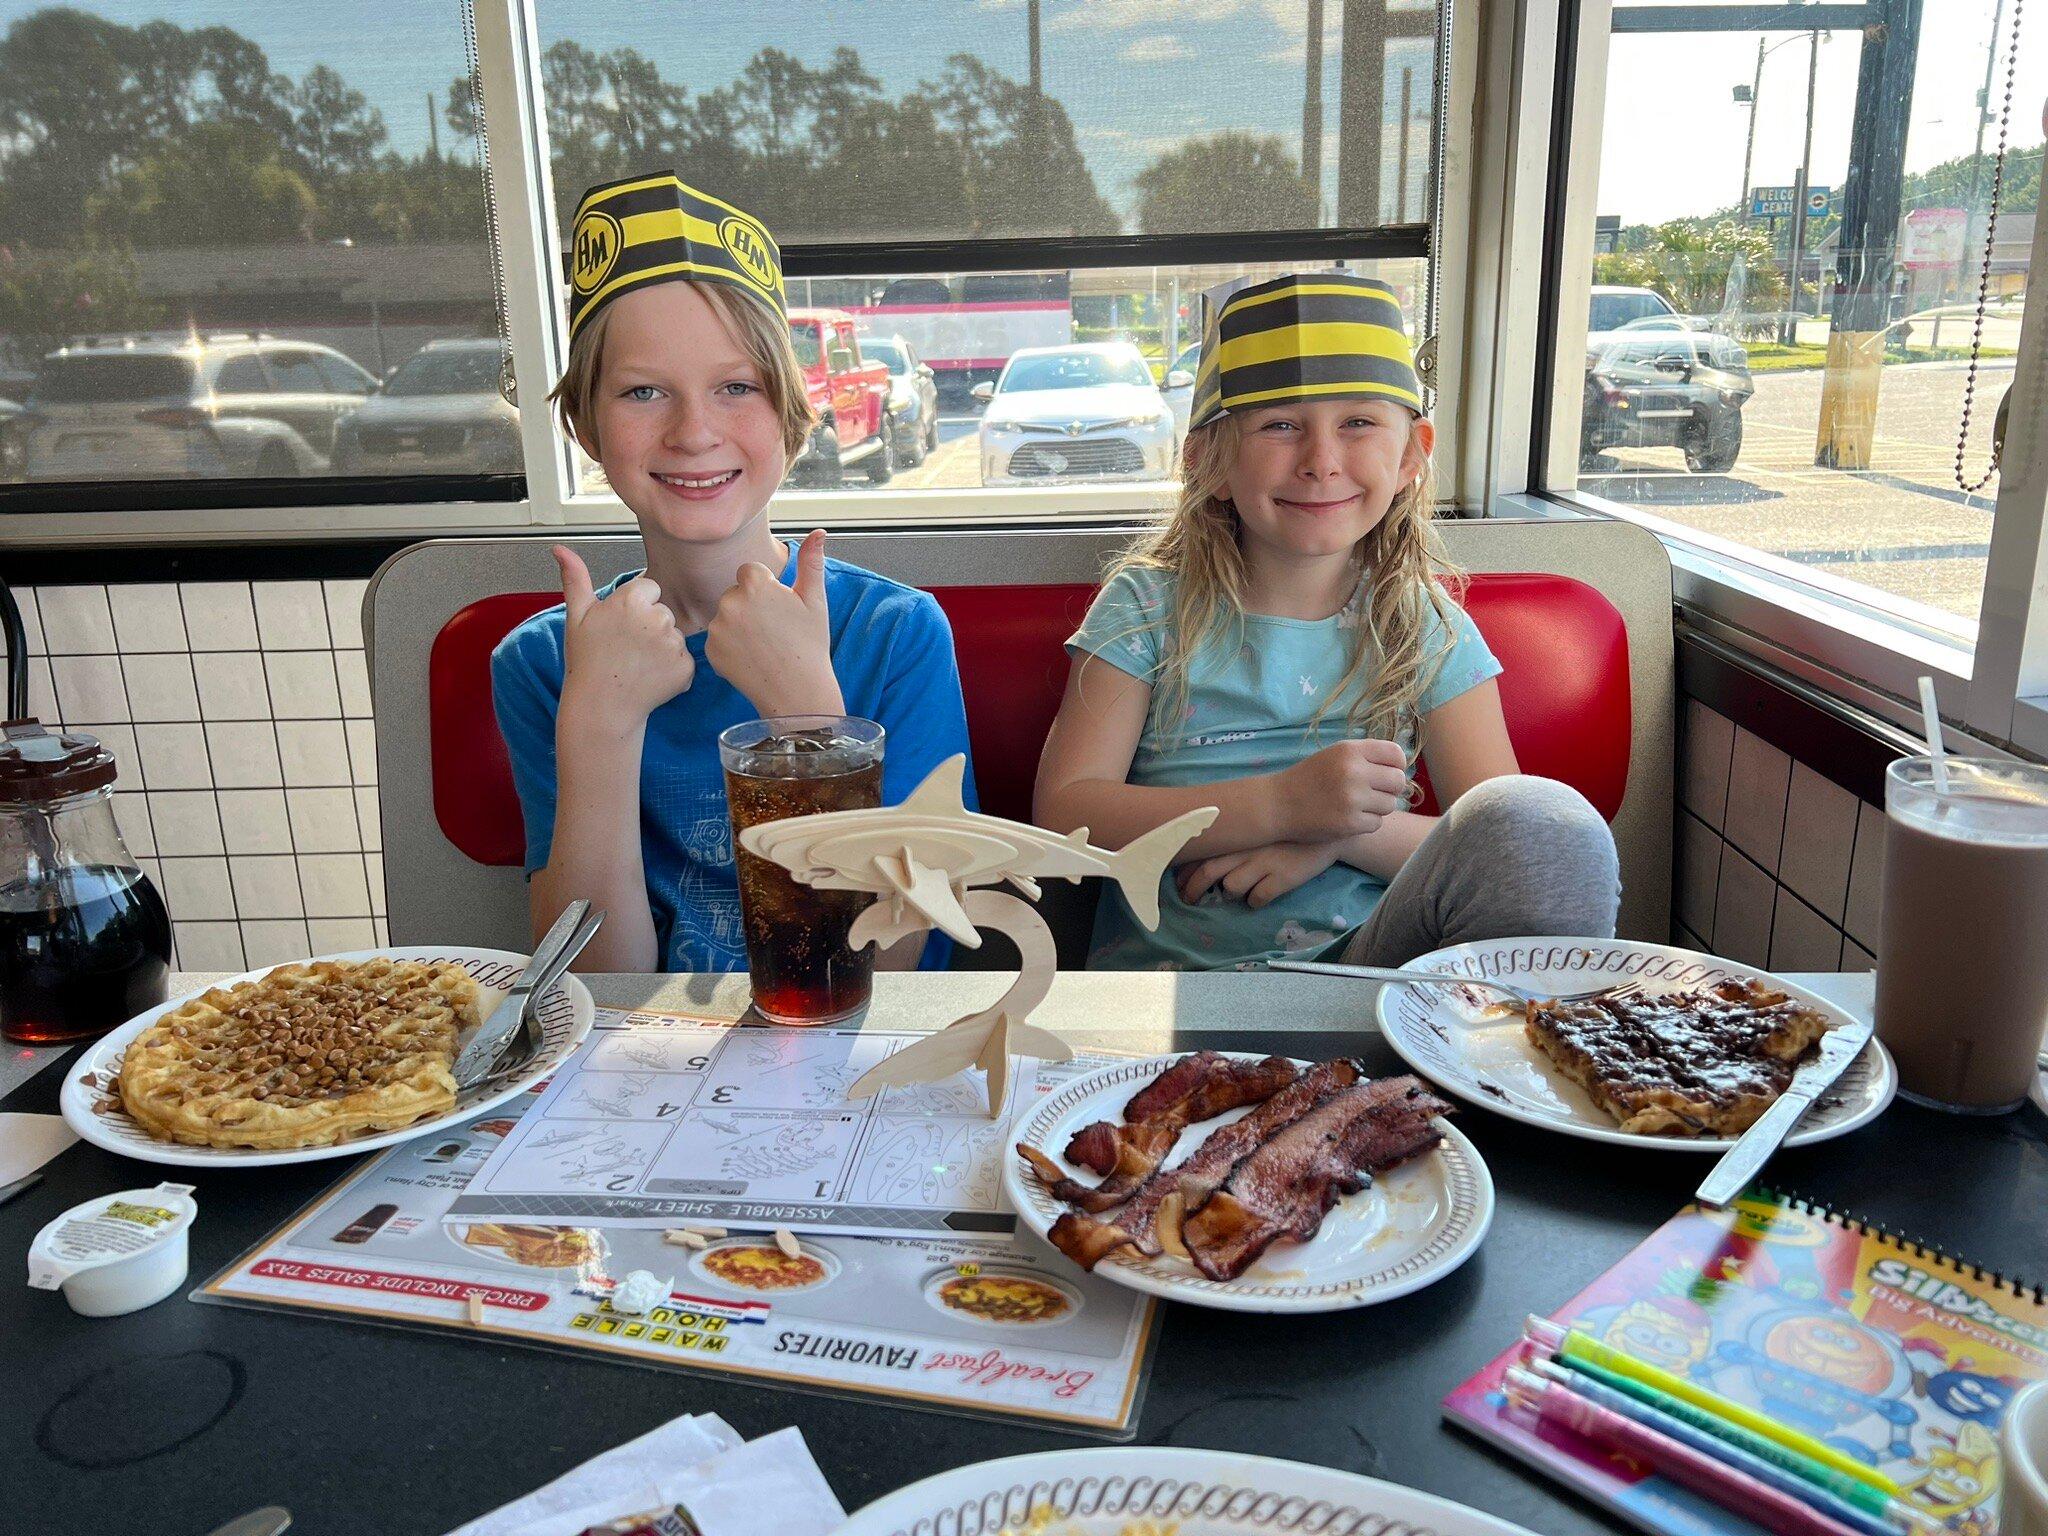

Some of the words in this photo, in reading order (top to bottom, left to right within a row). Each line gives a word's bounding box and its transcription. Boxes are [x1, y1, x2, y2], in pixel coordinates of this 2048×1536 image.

[1759, 188, 1794, 200] WELCO
[685, 1057, 709, 1071] 5
[711, 1086, 737, 1103] 3
[656, 1103, 680, 1118] 4
[606, 1175, 634, 1191] 2
[814, 1182, 829, 1198] 1
[652, 1201, 717, 1216] SHEET
[731, 1204, 835, 1220] ASSEMBLE
[257, 1261, 300, 1277] TAX
[306, 1267, 371, 1286] SALES
[372, 1275, 460, 1296] INCLUDE
[600, 1299, 724, 1333] HOUE
[570, 1315, 726, 1352] WAFFLE
[774, 1331, 918, 1370] FAVORITES
[922, 1350, 1095, 1398] Breakfast
